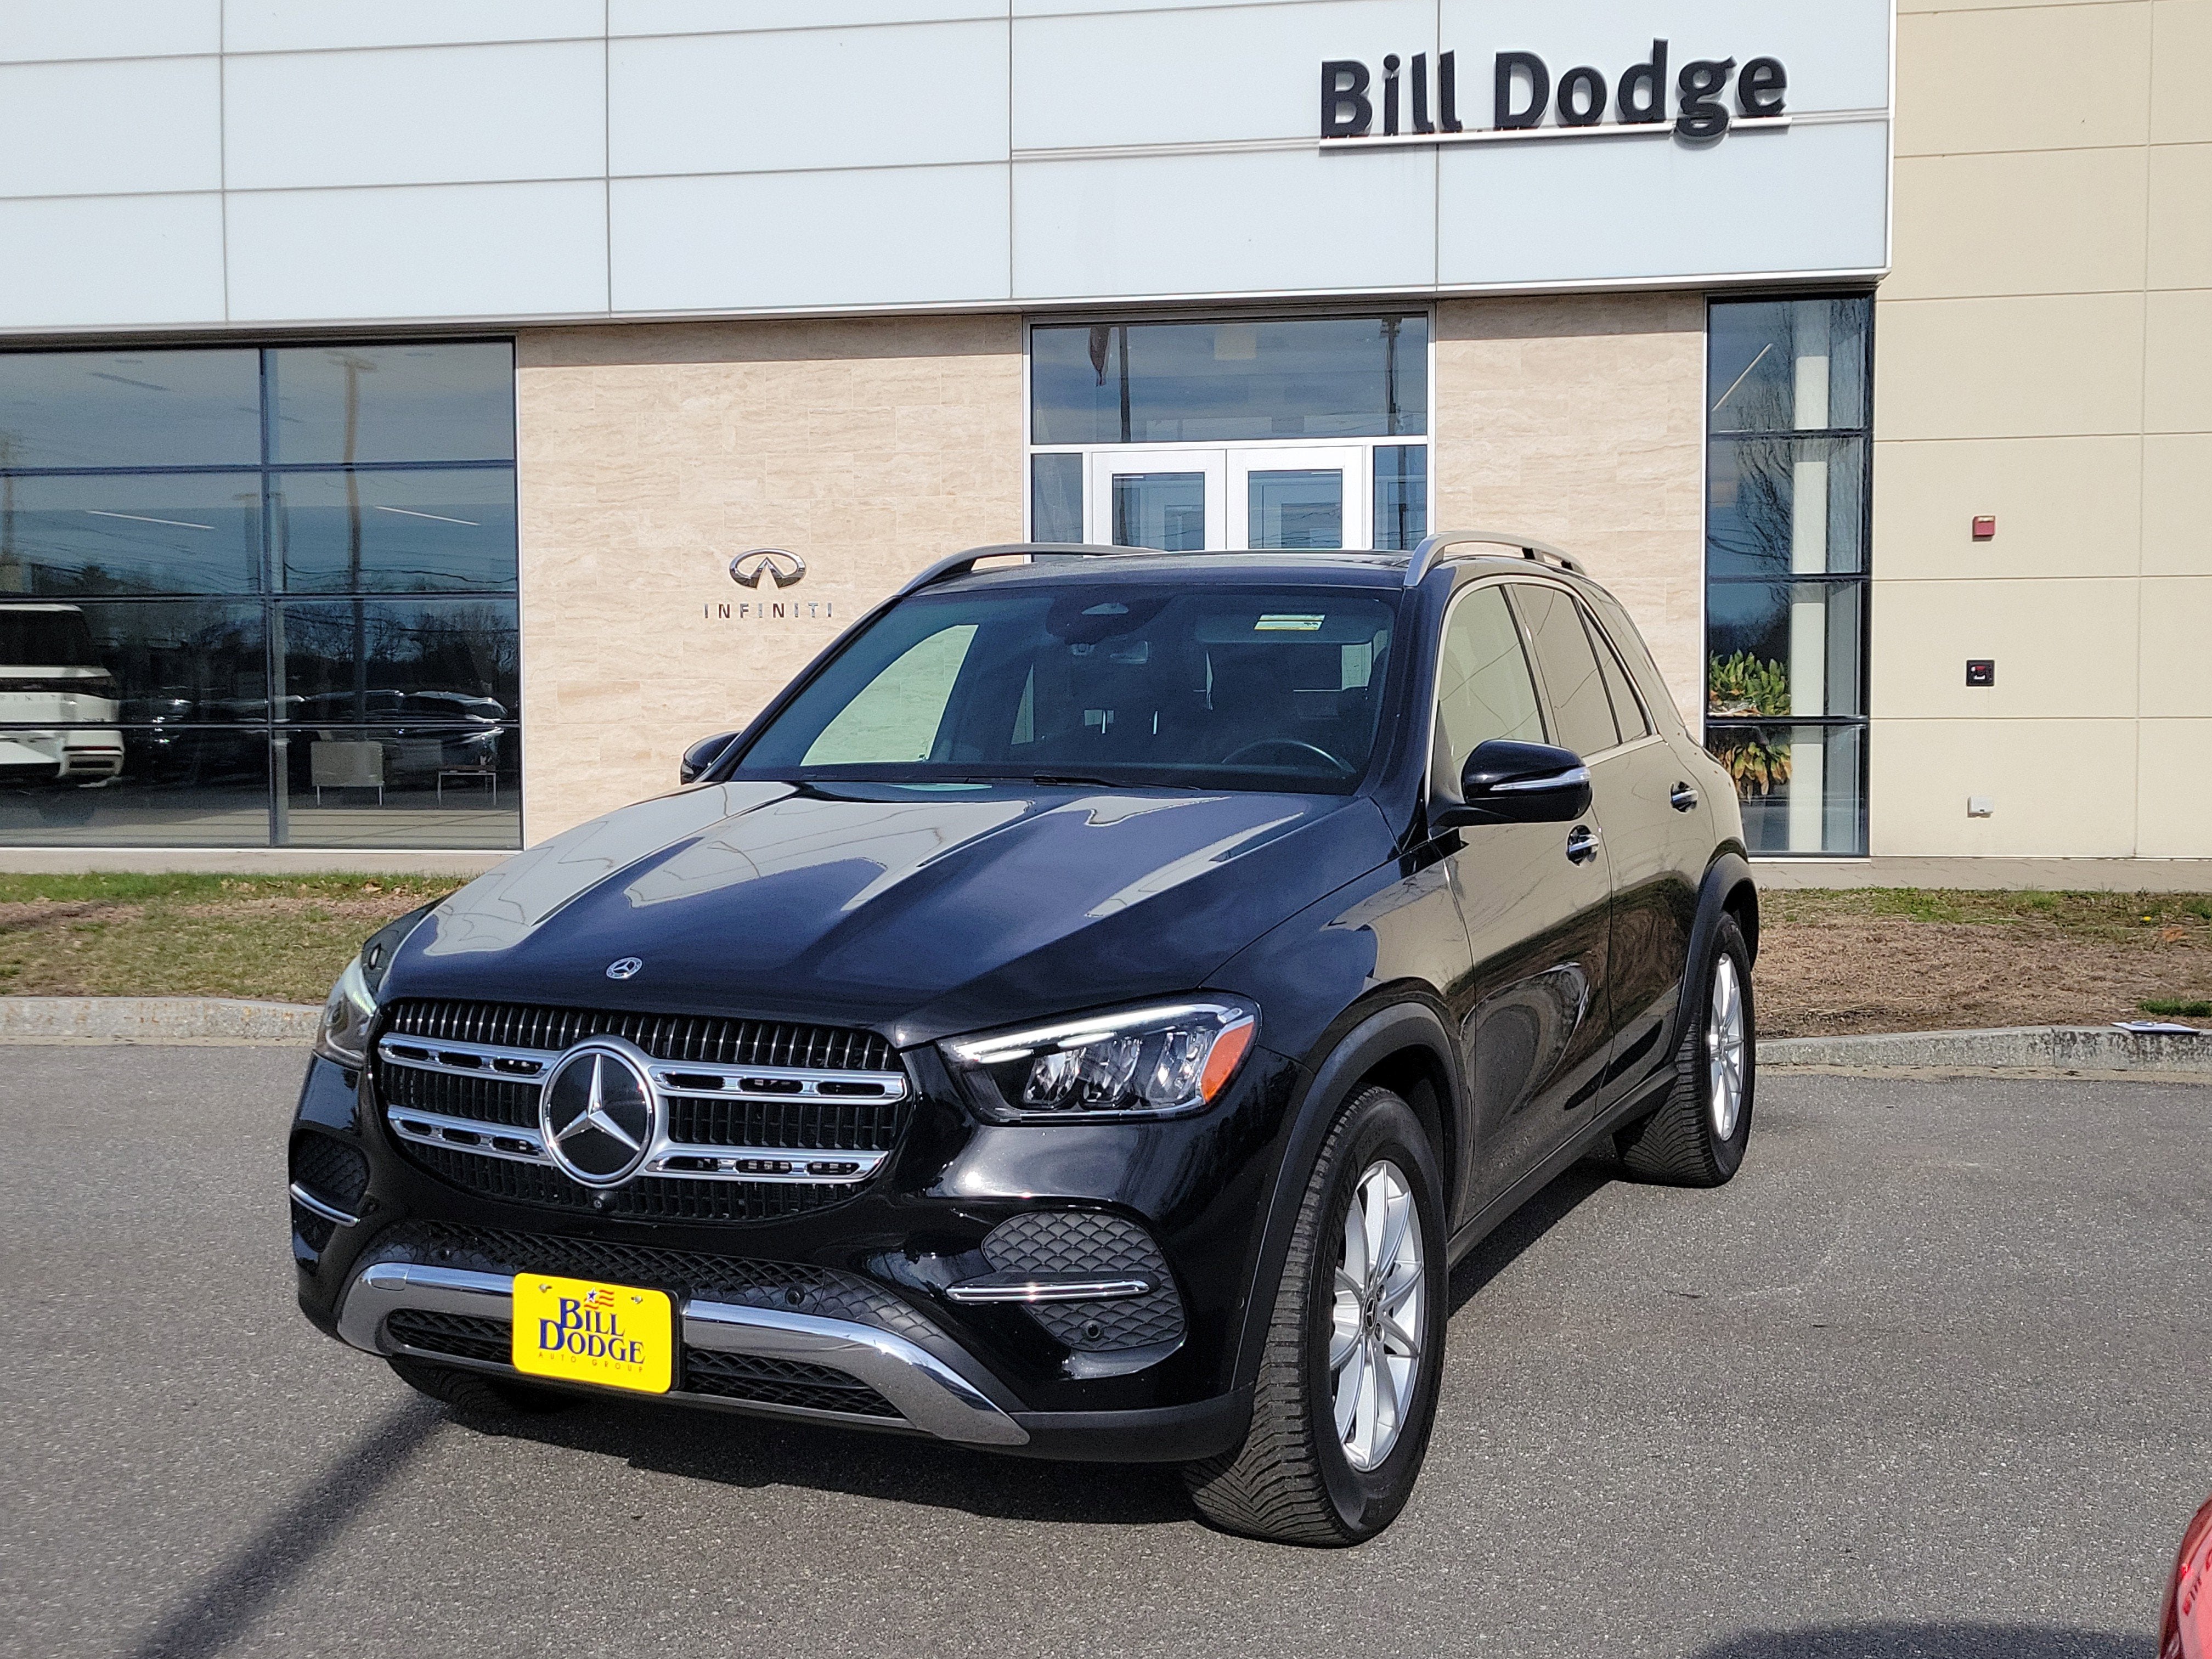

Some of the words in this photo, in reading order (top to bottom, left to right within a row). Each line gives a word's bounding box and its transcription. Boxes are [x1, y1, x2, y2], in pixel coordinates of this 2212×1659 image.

[1321, 49, 1463, 138] Bill
[1494, 37, 1788, 138] Dodge
[704, 602, 832, 619] INFINITI
[558, 1296, 625, 1337] BILL
[538, 1317, 646, 1365] DODGE
[538, 1351, 577, 1363] AUTO
[591, 1358, 644, 1373] GROUP
